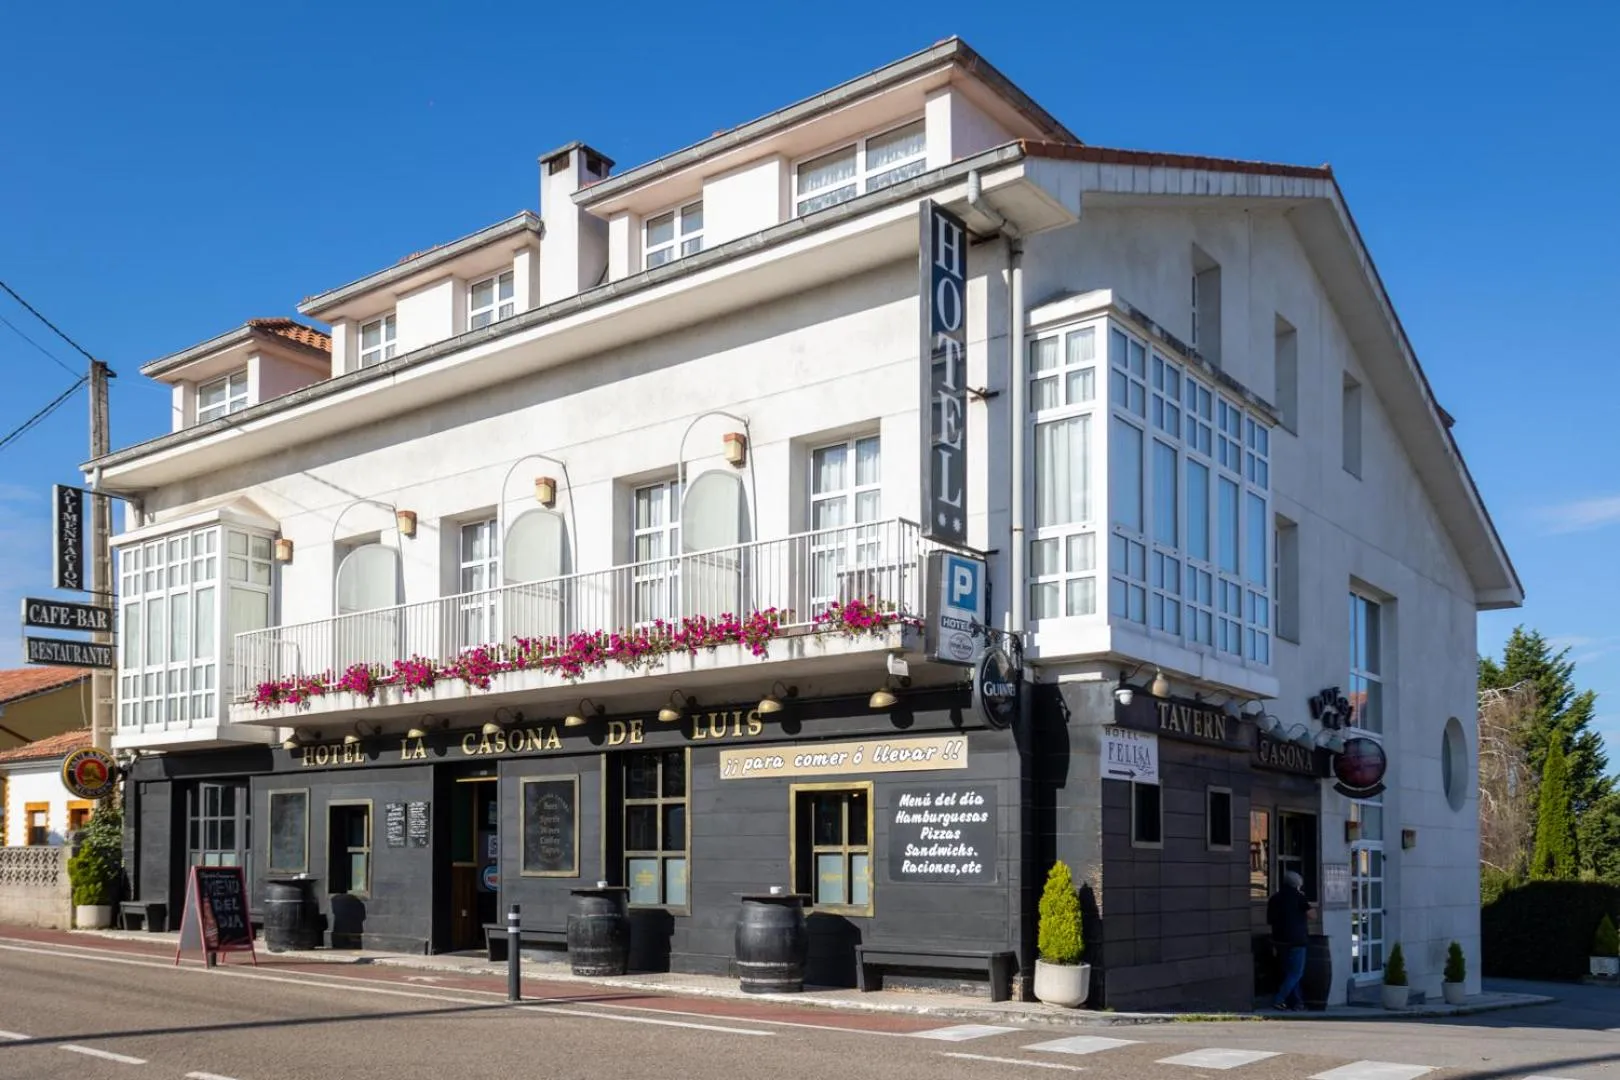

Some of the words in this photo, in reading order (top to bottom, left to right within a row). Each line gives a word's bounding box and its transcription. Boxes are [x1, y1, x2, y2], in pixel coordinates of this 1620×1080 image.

[935, 212, 963, 509] HOTEL
[953, 565, 973, 602] P
[29, 604, 107, 629] CAFE-BAR
[29, 640, 111, 666] RESTAURANTE
[1157, 701, 1226, 740] TAVERN
[301, 742, 365, 766] HOTEL
[400, 738, 427, 760] LA
[462, 726, 562, 755] CASONA
[607, 719, 644, 746] DE
[691, 708, 763, 740] LUIS
[742, 756, 784, 776] para
[794, 751, 848, 768] comer
[852, 745, 864, 765] ó
[873, 744, 937, 763] llevar
[1259, 740, 1313, 772] CASONA
[899, 793, 931, 807] Menú
[935, 792, 957, 806] del
[959, 791, 985, 805] día
[895, 810, 988, 827] Hamburguesas
[920, 826, 961, 840] Pizzas
[904, 843, 979, 857] Sandwichs.
[901, 860, 983, 876] Raciones,etc
